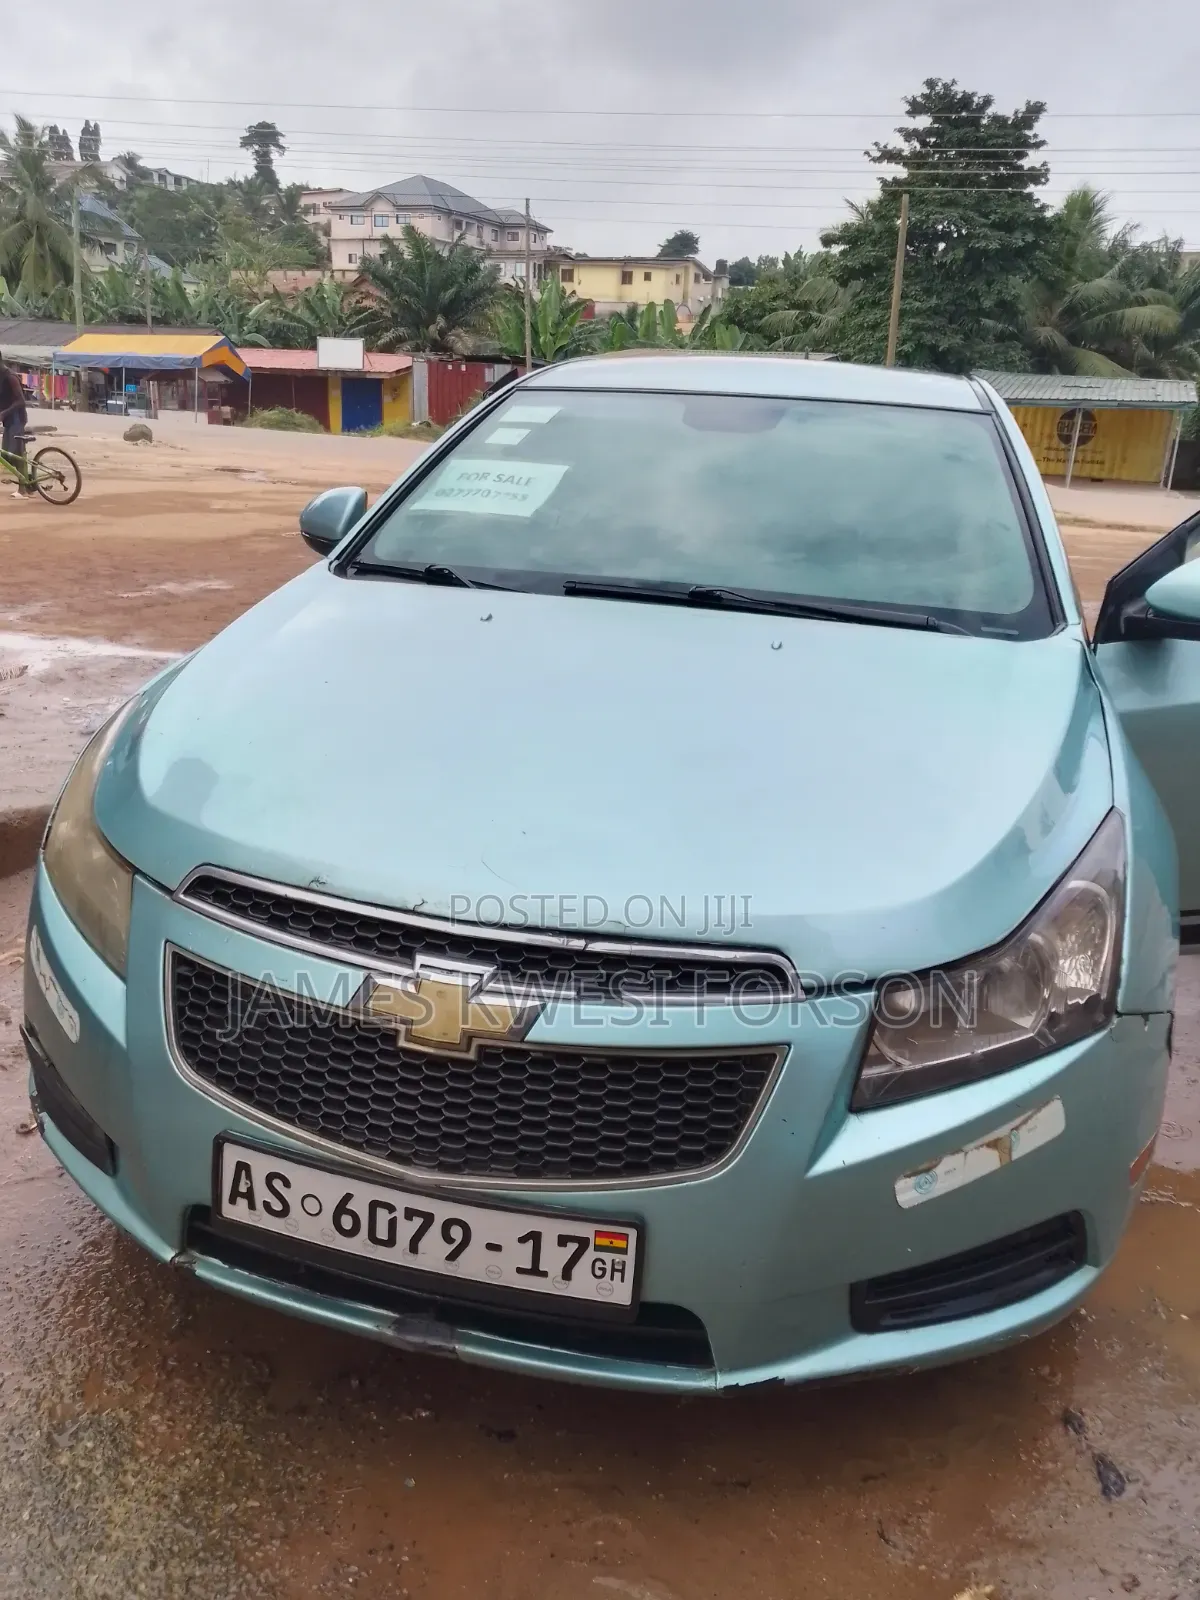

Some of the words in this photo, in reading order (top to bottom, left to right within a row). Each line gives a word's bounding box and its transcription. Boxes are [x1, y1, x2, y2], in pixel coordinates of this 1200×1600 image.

[456, 472, 491, 482] FOR
[493, 473, 537, 487] SALE
[228, 1160, 292, 1219] AS
[590, 1257, 627, 1284] GH
